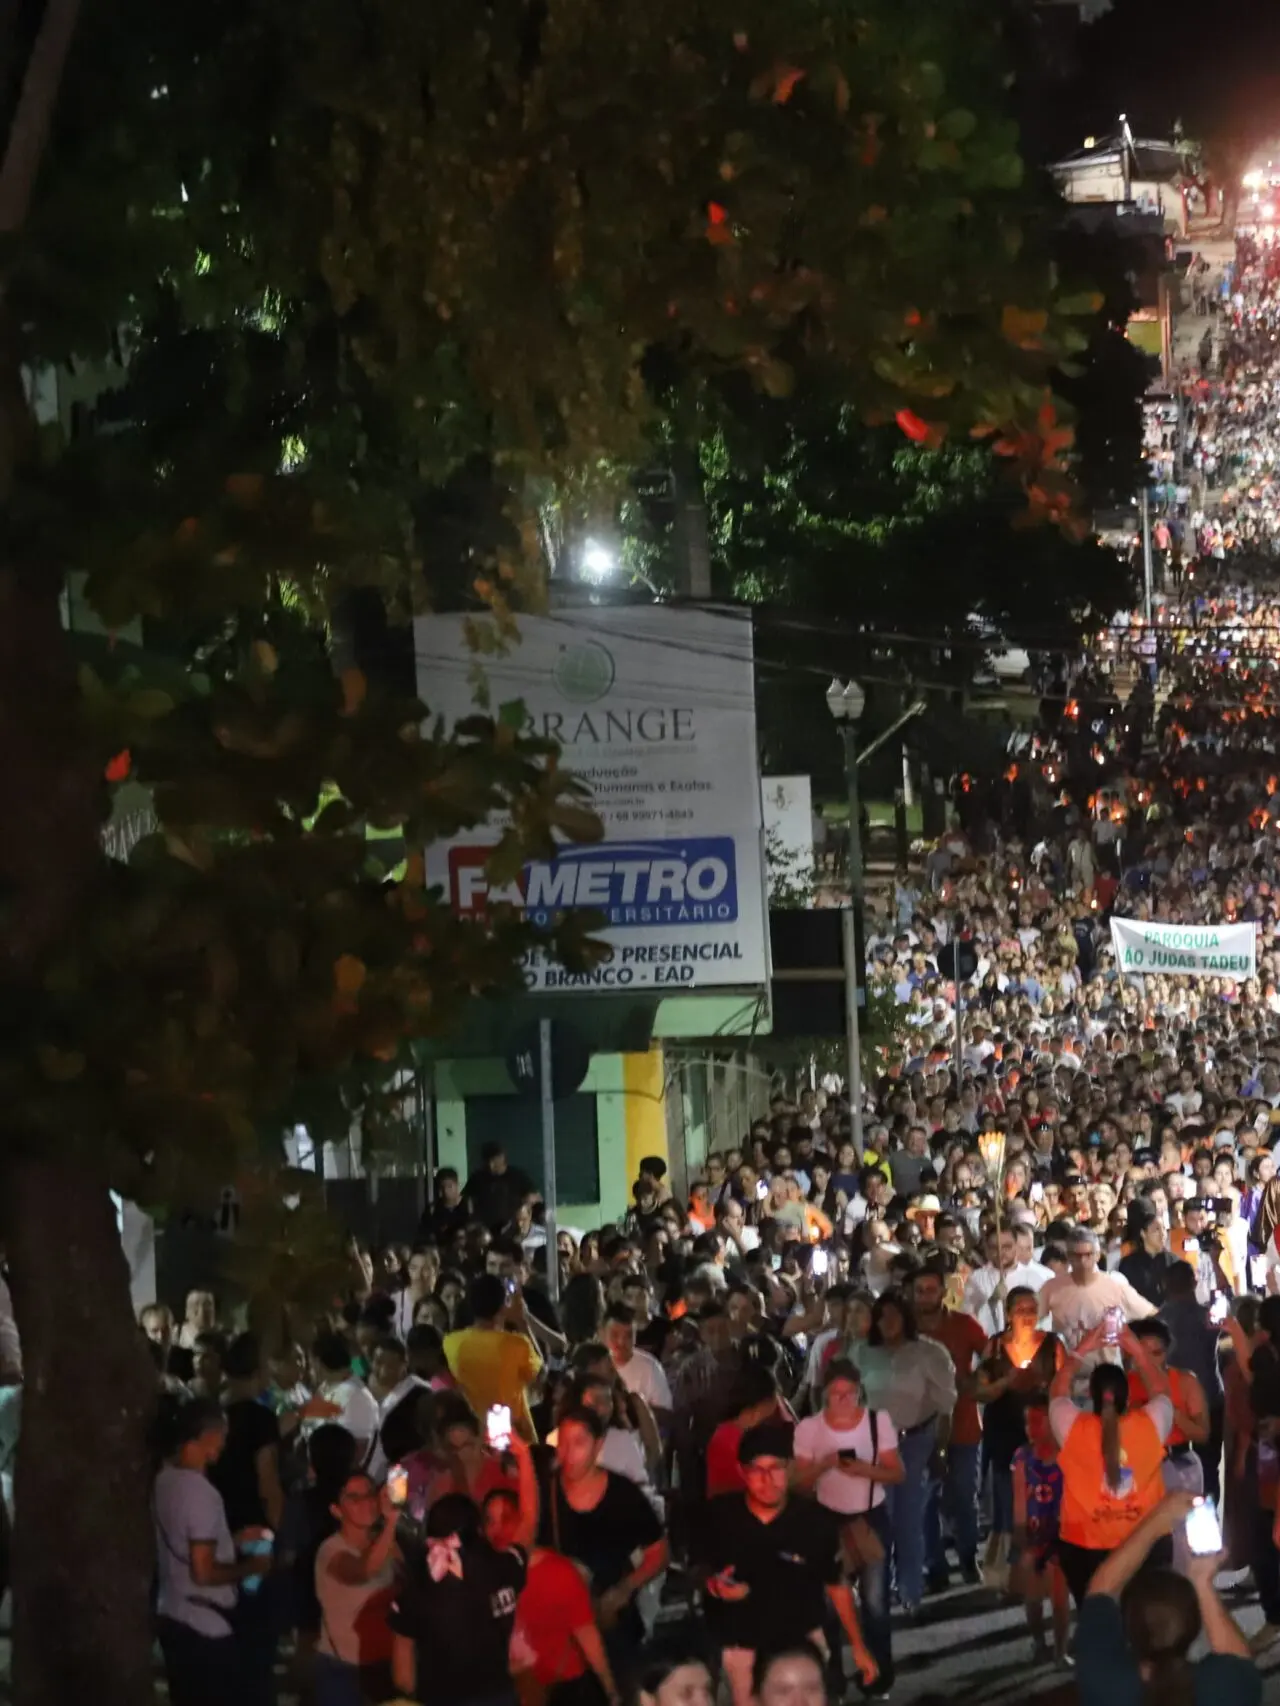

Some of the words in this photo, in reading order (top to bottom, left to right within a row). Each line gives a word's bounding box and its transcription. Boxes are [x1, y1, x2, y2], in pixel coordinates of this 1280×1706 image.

[457, 857, 728, 908] FAMETRO
[622, 942, 743, 963] PRESENCIAL
[1125, 944, 1144, 965] ÃO
[1148, 950, 1196, 968] JUDAS
[1200, 954, 1249, 971] TADEU
[545, 967, 633, 986] BRANCO
[654, 965, 694, 983] EAD
